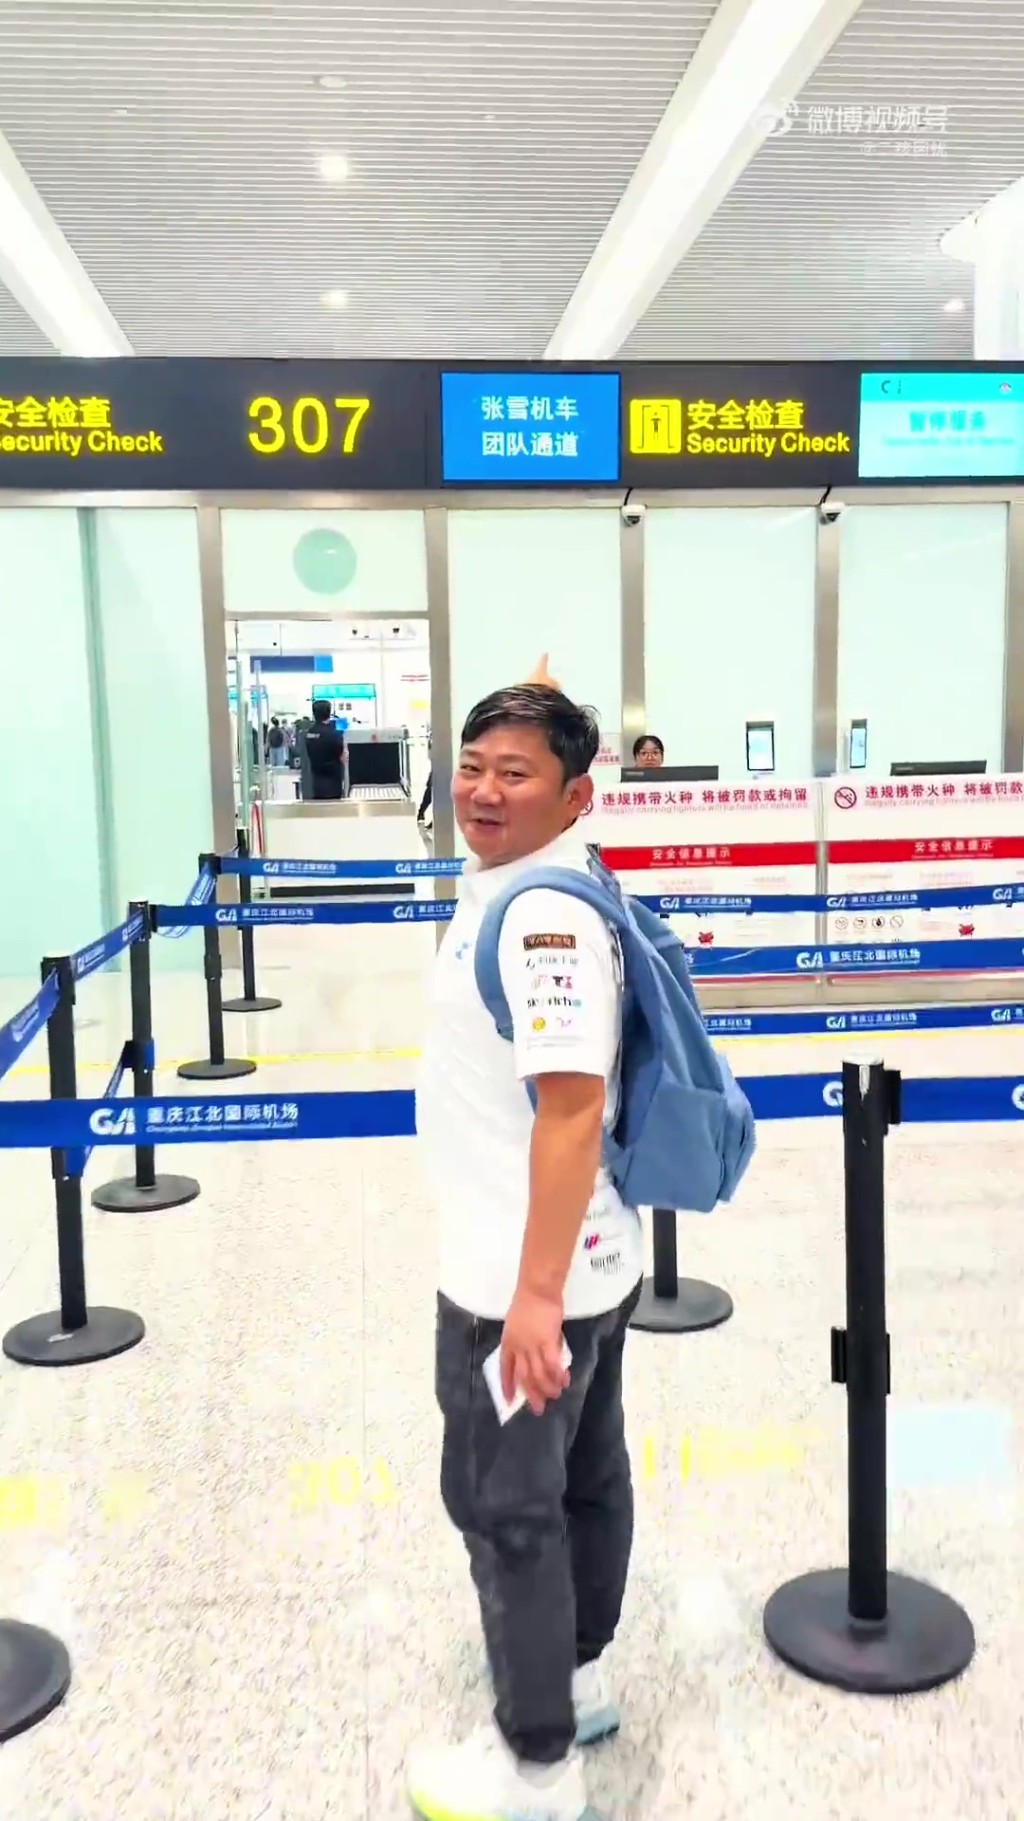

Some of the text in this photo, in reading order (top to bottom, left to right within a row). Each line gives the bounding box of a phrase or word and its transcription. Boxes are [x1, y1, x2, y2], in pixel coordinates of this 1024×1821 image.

[482, 396, 578, 421] 张雪机车
[687, 400, 804, 430] 安全检查
[248, 397, 370, 453] 307
[0, 430, 163, 457] ecurity Check
[482, 431, 578, 457] 团队通道
[687, 431, 850, 458] Security Check
[601, 787, 808, 806] 违规携带火种 将被罚款或拘留
[865, 783, 955, 799] 违规携带火种
[147, 1102, 299, 1124] 重庆江北国际机场
